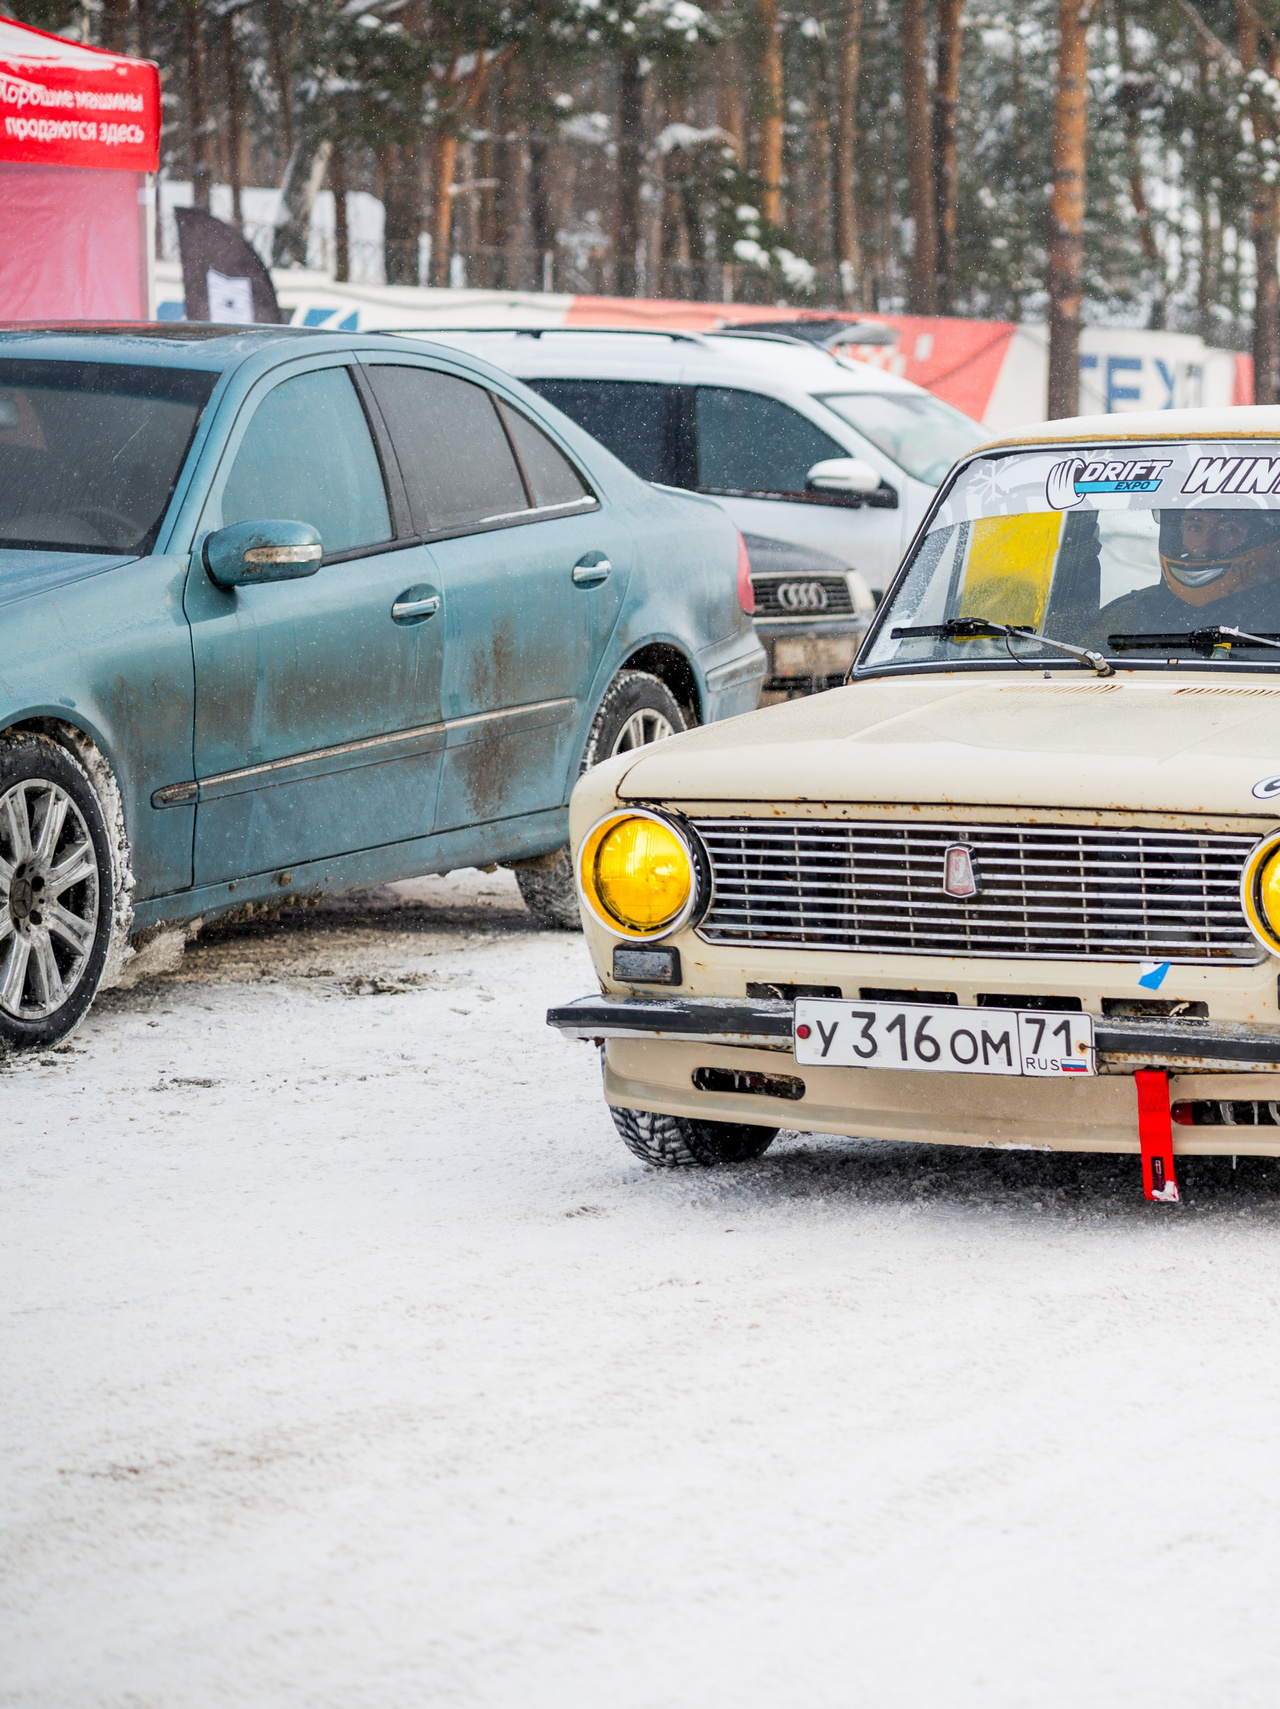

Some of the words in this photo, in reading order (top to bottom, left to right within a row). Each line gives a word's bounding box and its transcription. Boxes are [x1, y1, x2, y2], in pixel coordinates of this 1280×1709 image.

[74, 91, 144, 112] машины
[5, 116, 97, 141] продаются
[99, 122, 145, 146] здесь
[1079, 460, 1173, 482] DRIFT
[1114, 482, 1151, 490] EXPO
[1024, 1018, 1072, 1057] 71
[1026, 1057, 1060, 1071] RUS
